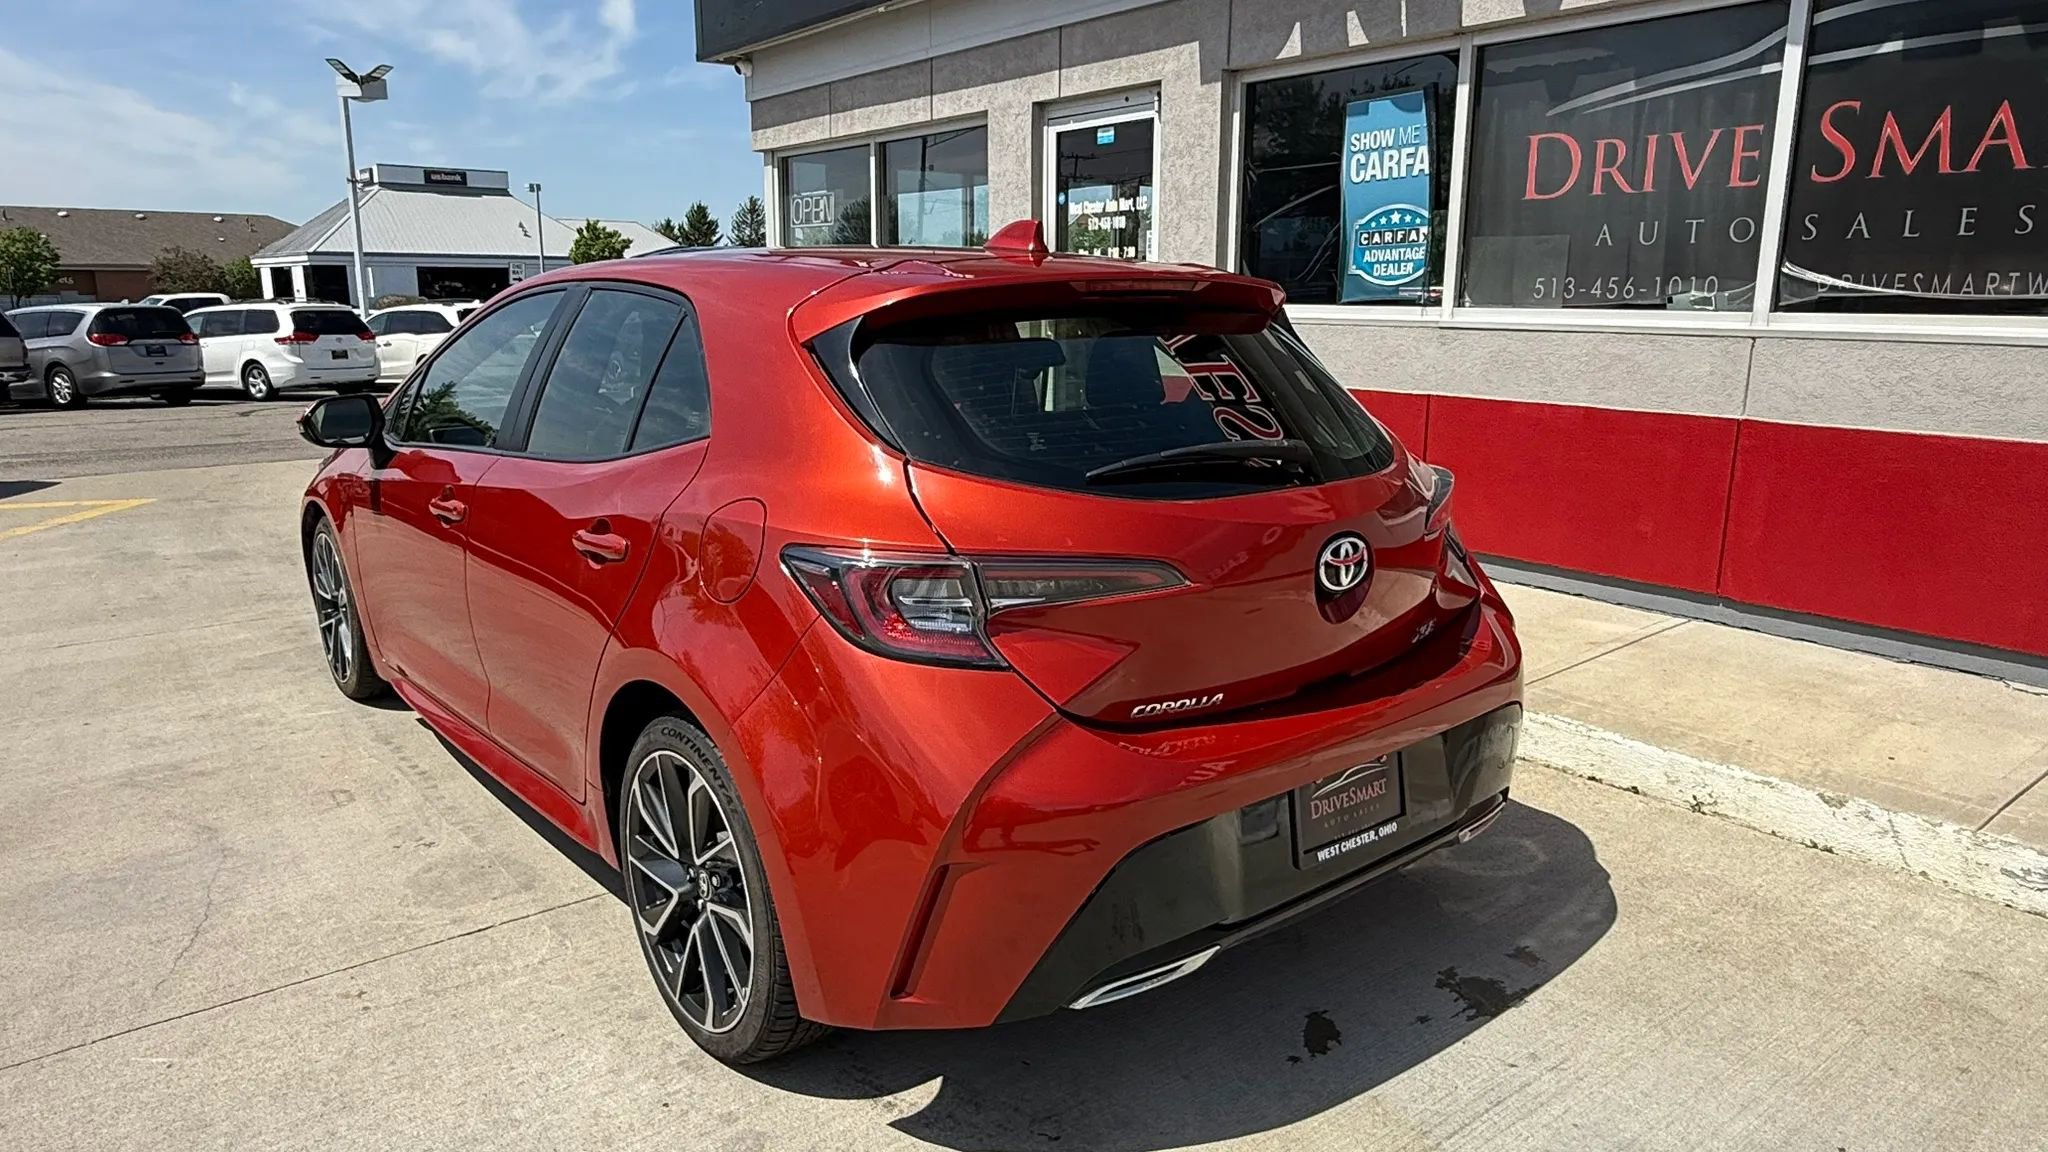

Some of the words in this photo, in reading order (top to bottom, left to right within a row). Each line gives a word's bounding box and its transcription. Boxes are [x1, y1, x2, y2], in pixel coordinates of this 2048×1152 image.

[1350, 128, 1395, 153] SHOW
[1399, 124, 1421, 147] ME
[1522, 124, 1765, 200] DRIVE
[1811, 99, 2048, 183] SMA
[793, 195, 832, 224] OPEN
[1594, 217, 1756, 247] AUTO
[1801, 204, 2036, 241] SALES
[1363, 245, 1426, 264] ADVANTAGE
[1373, 262, 1414, 277] DEALER
[1533, 276, 1719, 299] 513-456-1010
[1130, 693, 1224, 719] COROLLA
[1317, 843, 1341, 862] WEST
[1341, 830, 1378, 853] CHESTER,
[1378, 821, 1398, 838] OHIO
